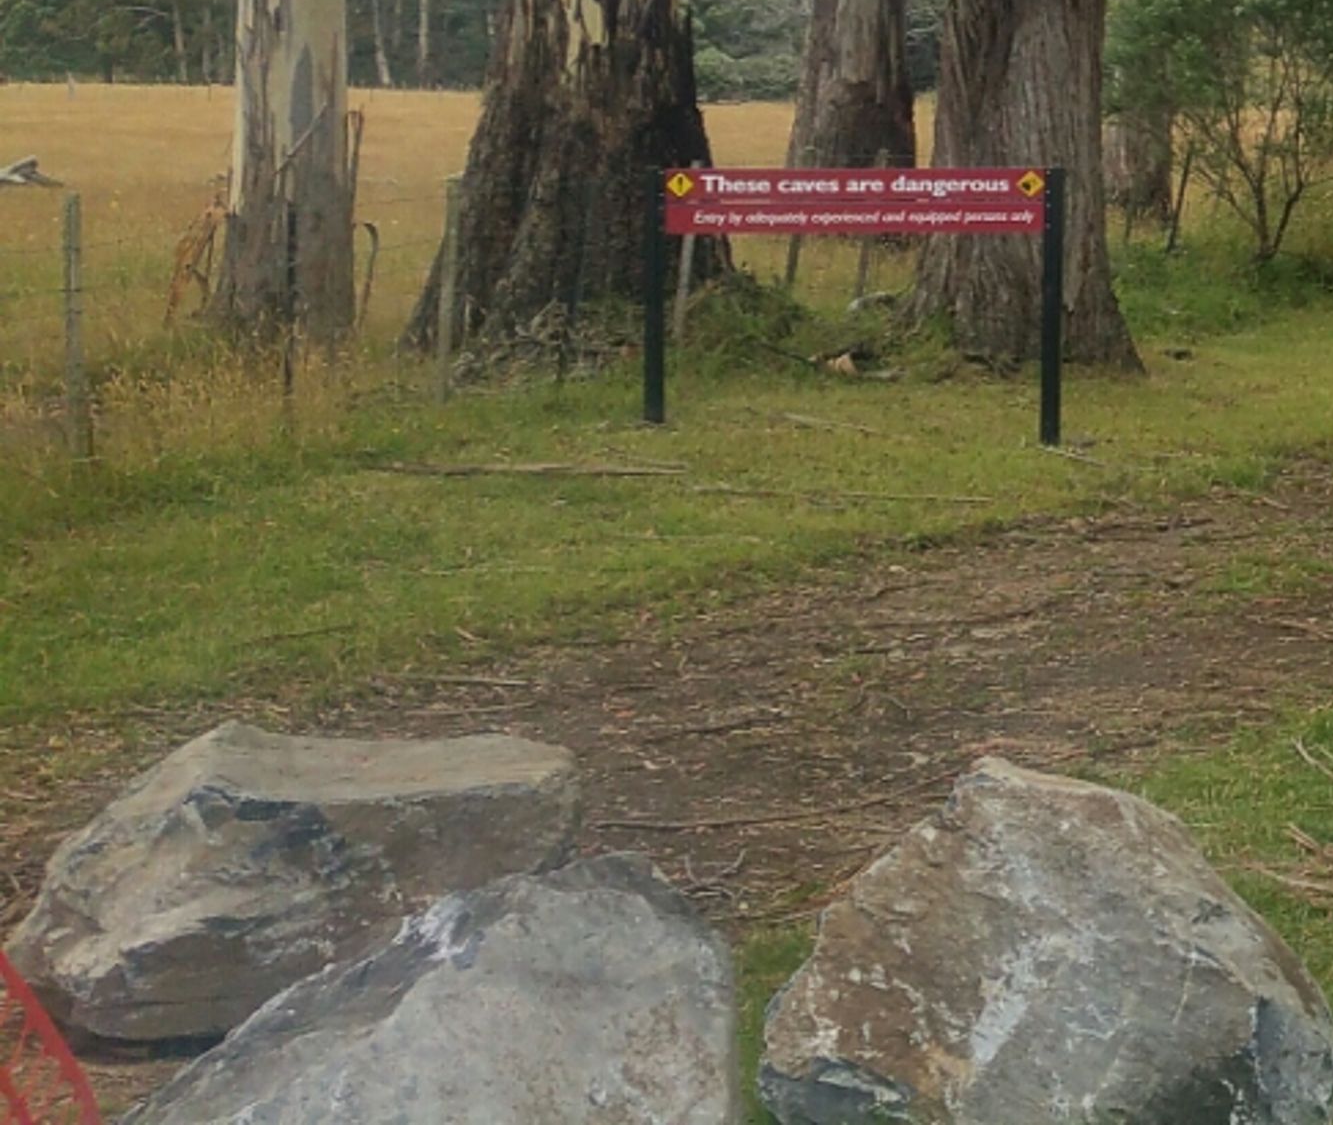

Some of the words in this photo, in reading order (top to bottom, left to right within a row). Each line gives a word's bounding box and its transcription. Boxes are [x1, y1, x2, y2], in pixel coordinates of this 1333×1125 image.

[700, 175, 771, 193] These
[777, 179, 839, 193] caves
[846, 179, 884, 193] are
[891, 175, 1009, 197] dangerous
[694, 210, 726, 226] Entry
[728, 211, 743, 226] by
[745, 211, 809, 226] adequately
[811, 210, 880, 226] experienced
[882, 210, 906, 223] and
[908, 210, 963, 225] equipped
[964, 211, 1008, 224] persons
[1011, 210, 1034, 224] only
